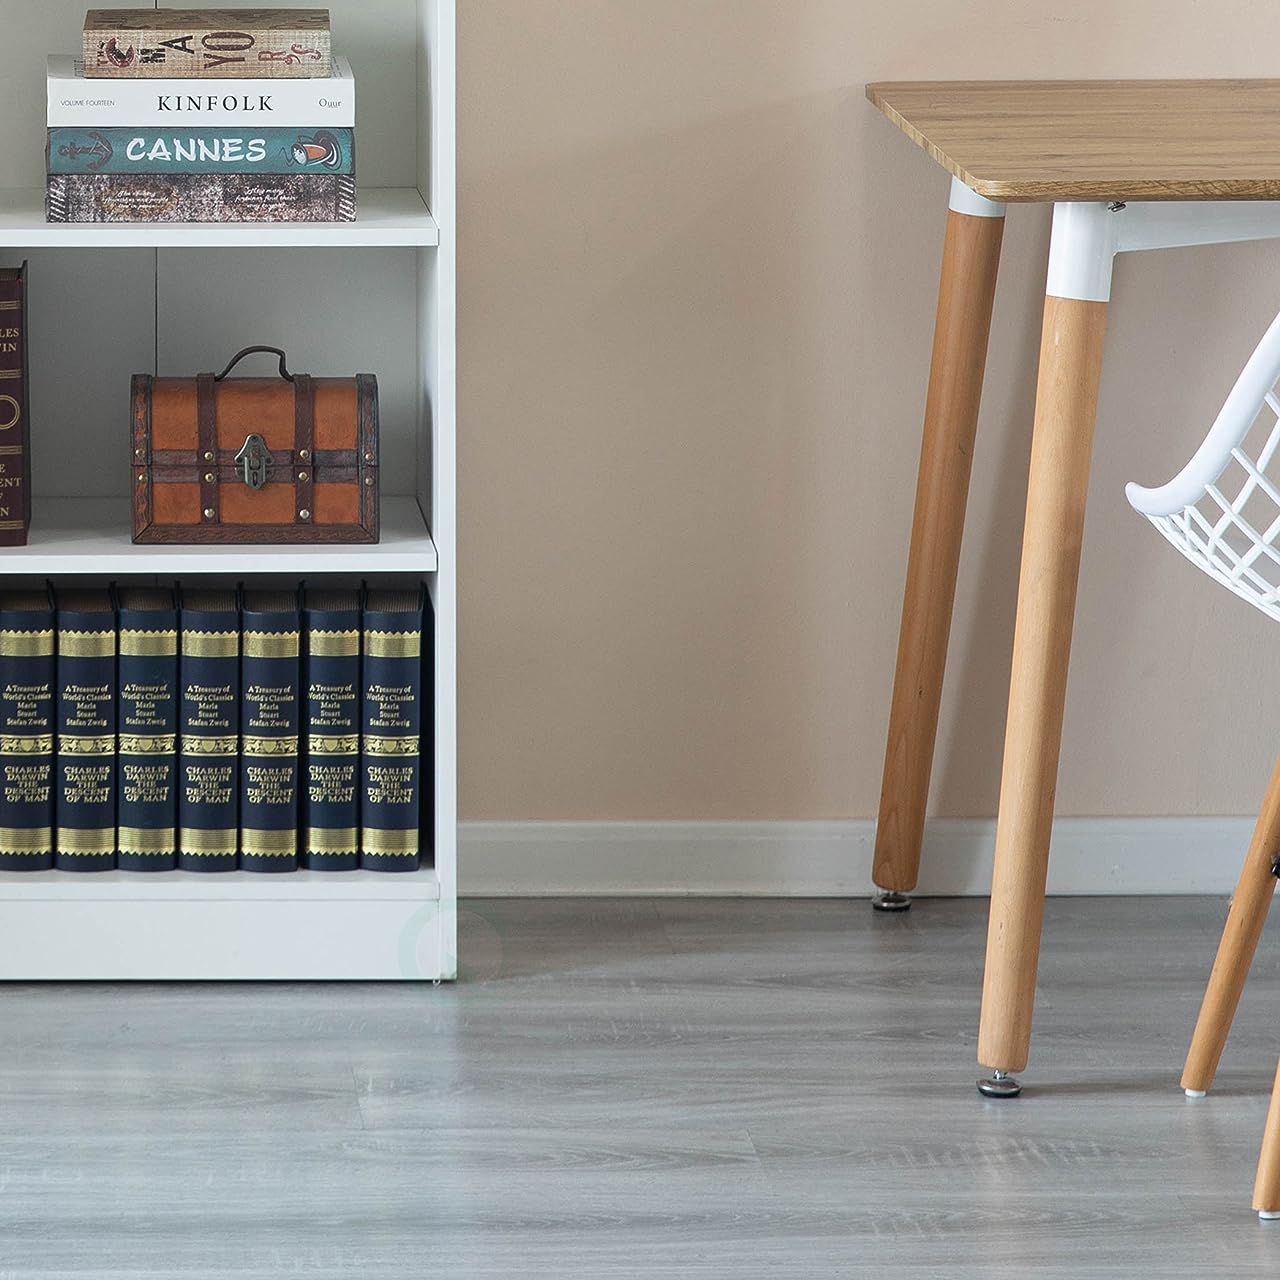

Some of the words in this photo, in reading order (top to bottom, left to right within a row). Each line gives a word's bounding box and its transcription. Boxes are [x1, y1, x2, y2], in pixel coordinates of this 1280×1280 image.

[157, 95, 274, 111] KINFOLK
[126, 137, 267, 162] CANNES
[186, 766, 232, 775] CHARLES
[367, 766, 413, 775] CHARLES
[186, 788, 232, 796] DESCENT
[367, 788, 414, 796] DESCENT
